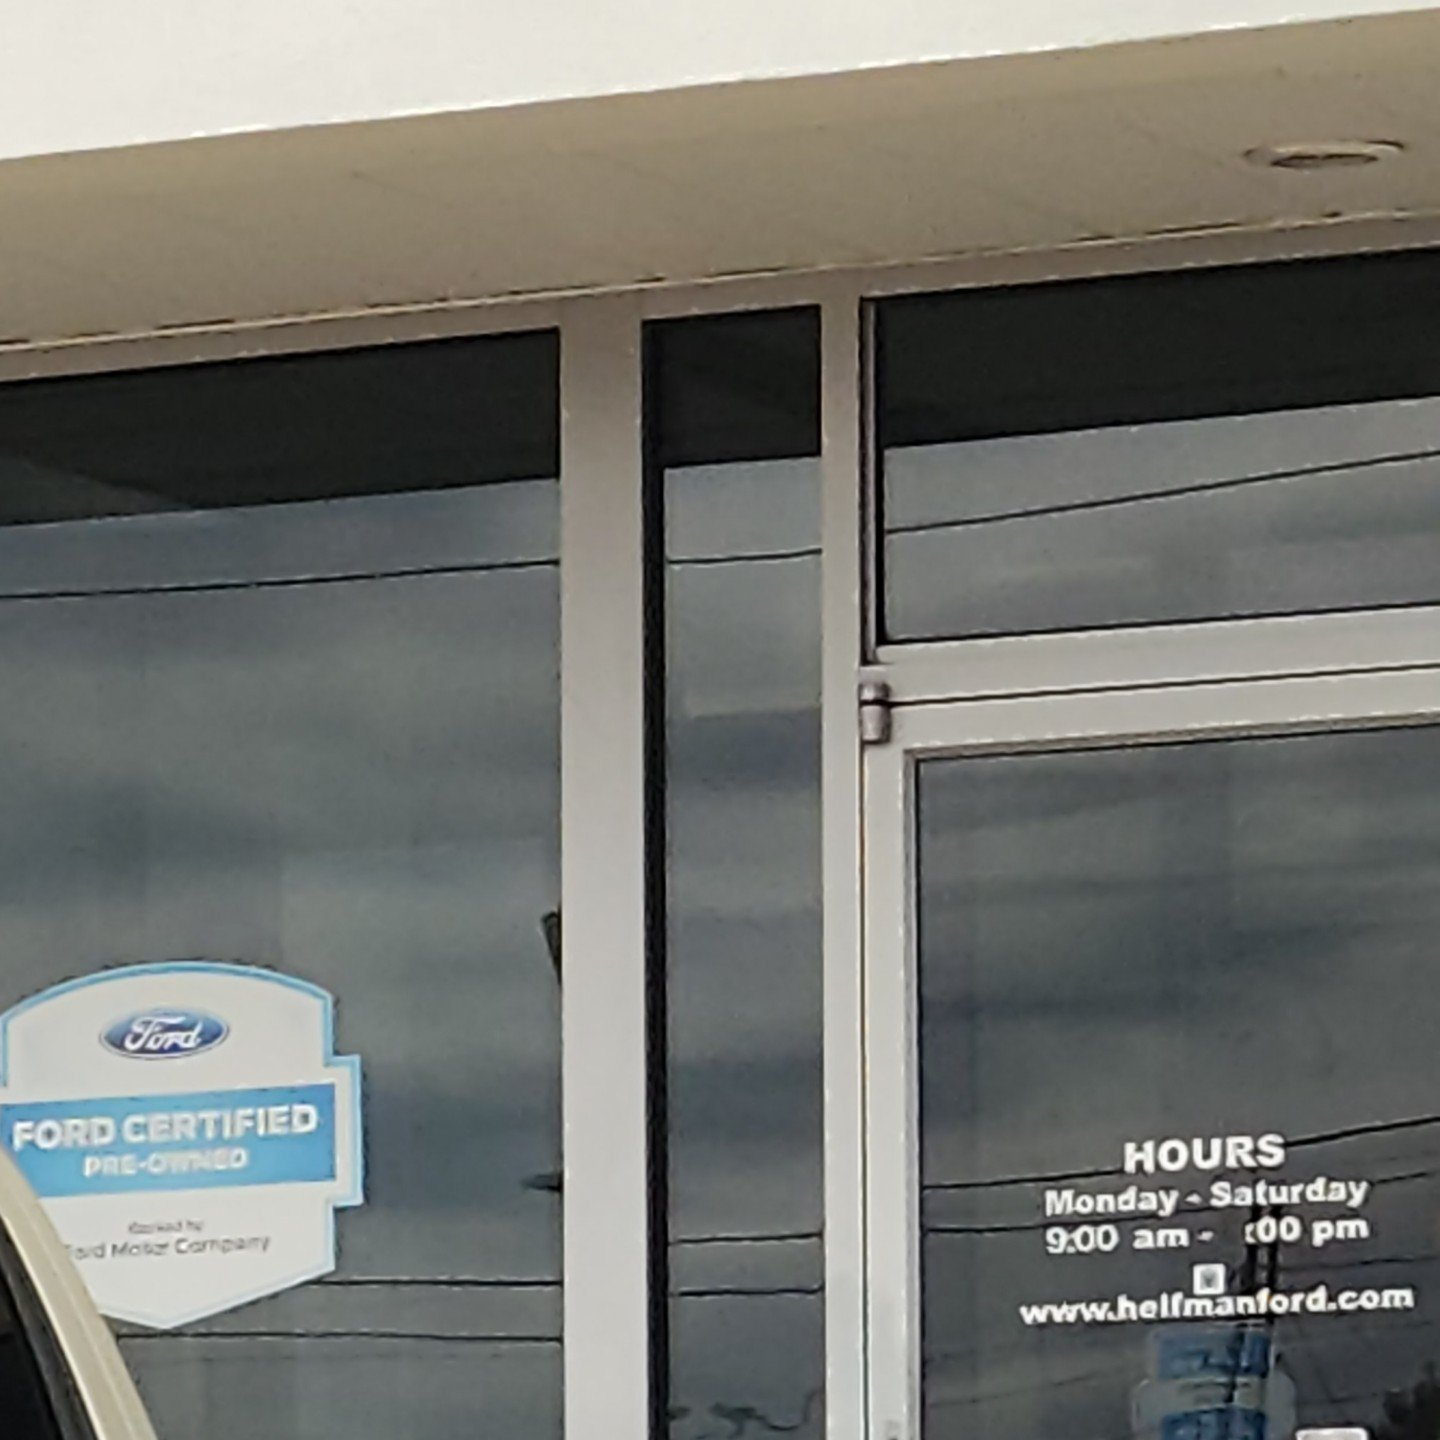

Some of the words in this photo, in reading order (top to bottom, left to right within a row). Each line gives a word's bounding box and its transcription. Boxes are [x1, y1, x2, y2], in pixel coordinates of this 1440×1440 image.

[123, 1015, 202, 1052] Ford
[12, 1117, 114, 1152] FORD
[122, 1104, 319, 1143] CERTIFIED
[84, 1147, 248, 1178] PRE-OWNED
[1123, 1133, 1286, 1174] HOURS
[1044, 1185, 1180, 1217] Monday
[1209, 1177, 1370, 1208] Saturday
[1045, 1225, 1120, 1254] 9:00
[1132, 1229, 1190, 1249] am
[1312, 1218, 1370, 1247] pm
[1019, 1285, 1416, 1325] www.helfmanford.com
